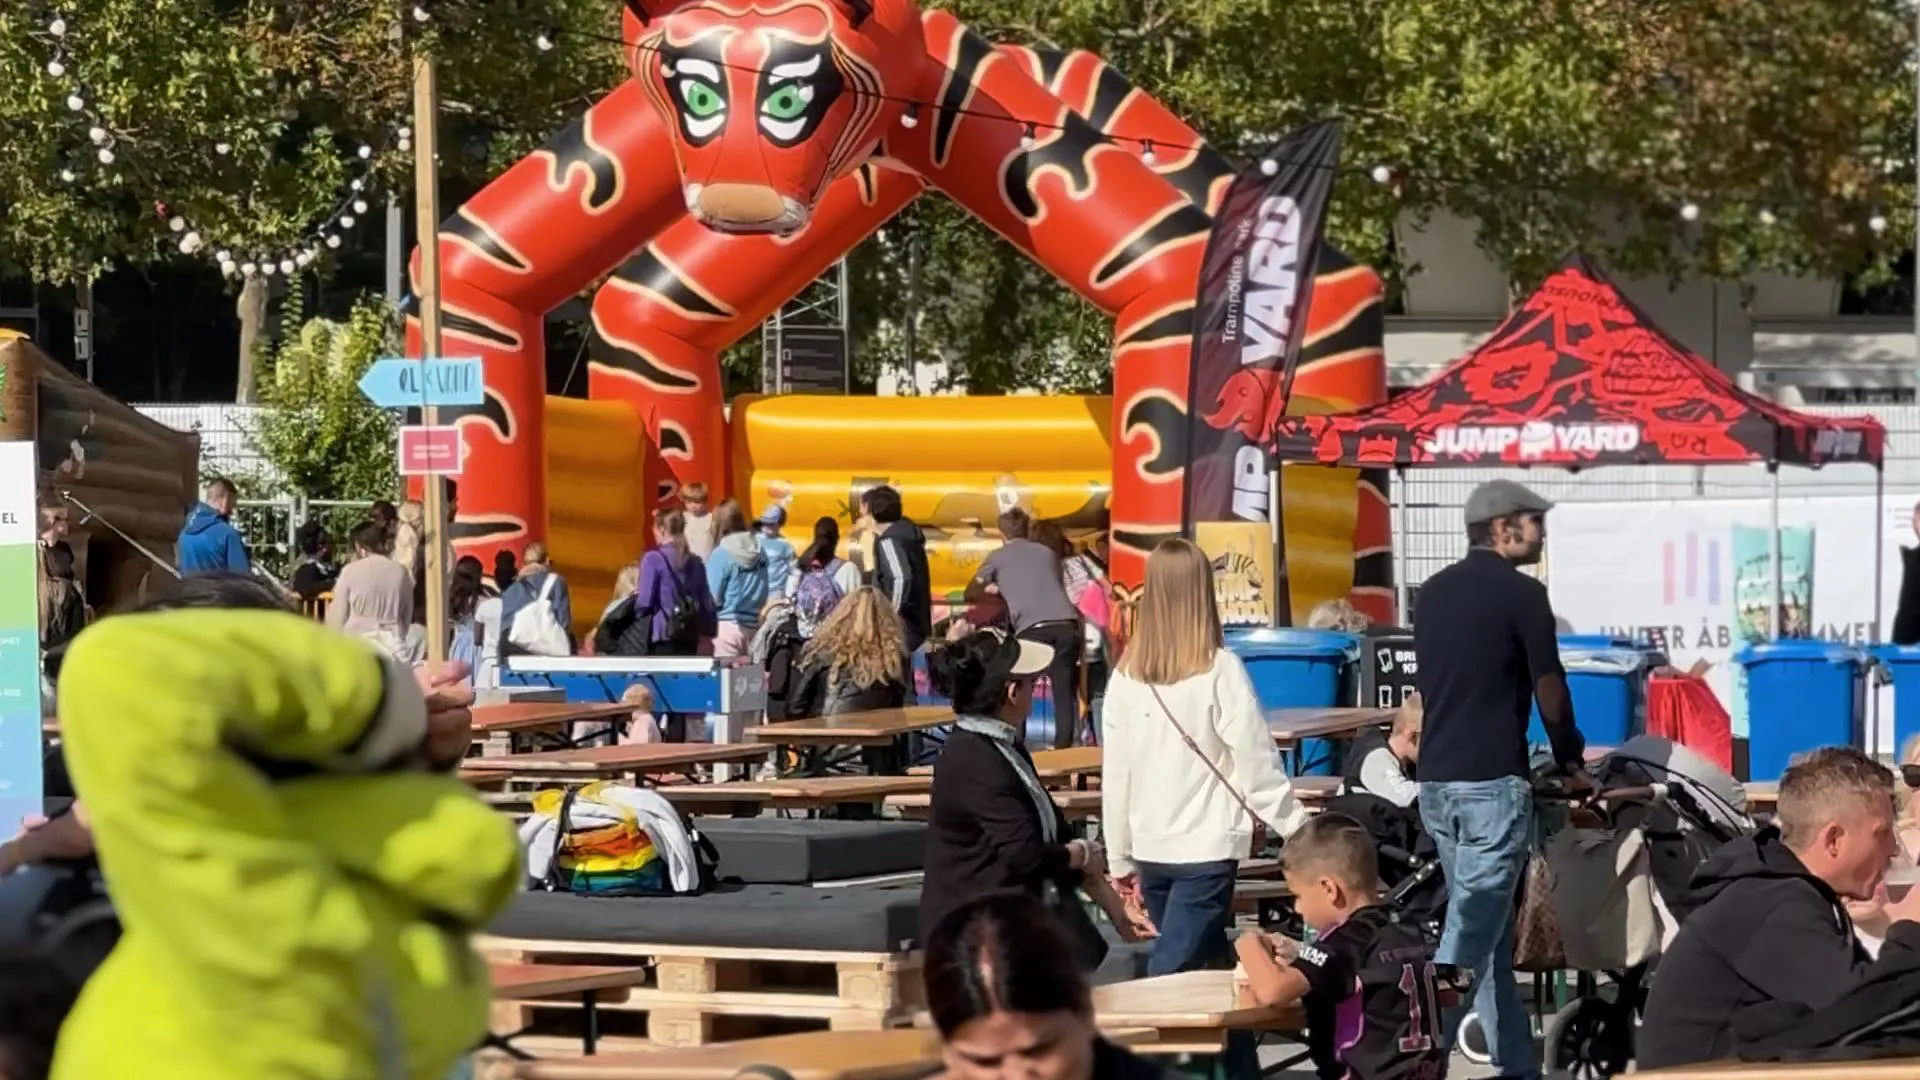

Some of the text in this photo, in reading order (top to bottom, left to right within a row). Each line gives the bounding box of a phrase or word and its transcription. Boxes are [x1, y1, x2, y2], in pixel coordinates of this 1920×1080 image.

[1221, 254, 1245, 344] Trampoline
[1241, 195, 1302, 365] YARD
[1424, 425, 1520, 454] JUMP
[1556, 424, 1640, 452] YARD
[1697, 616, 1732, 649] ÅB
